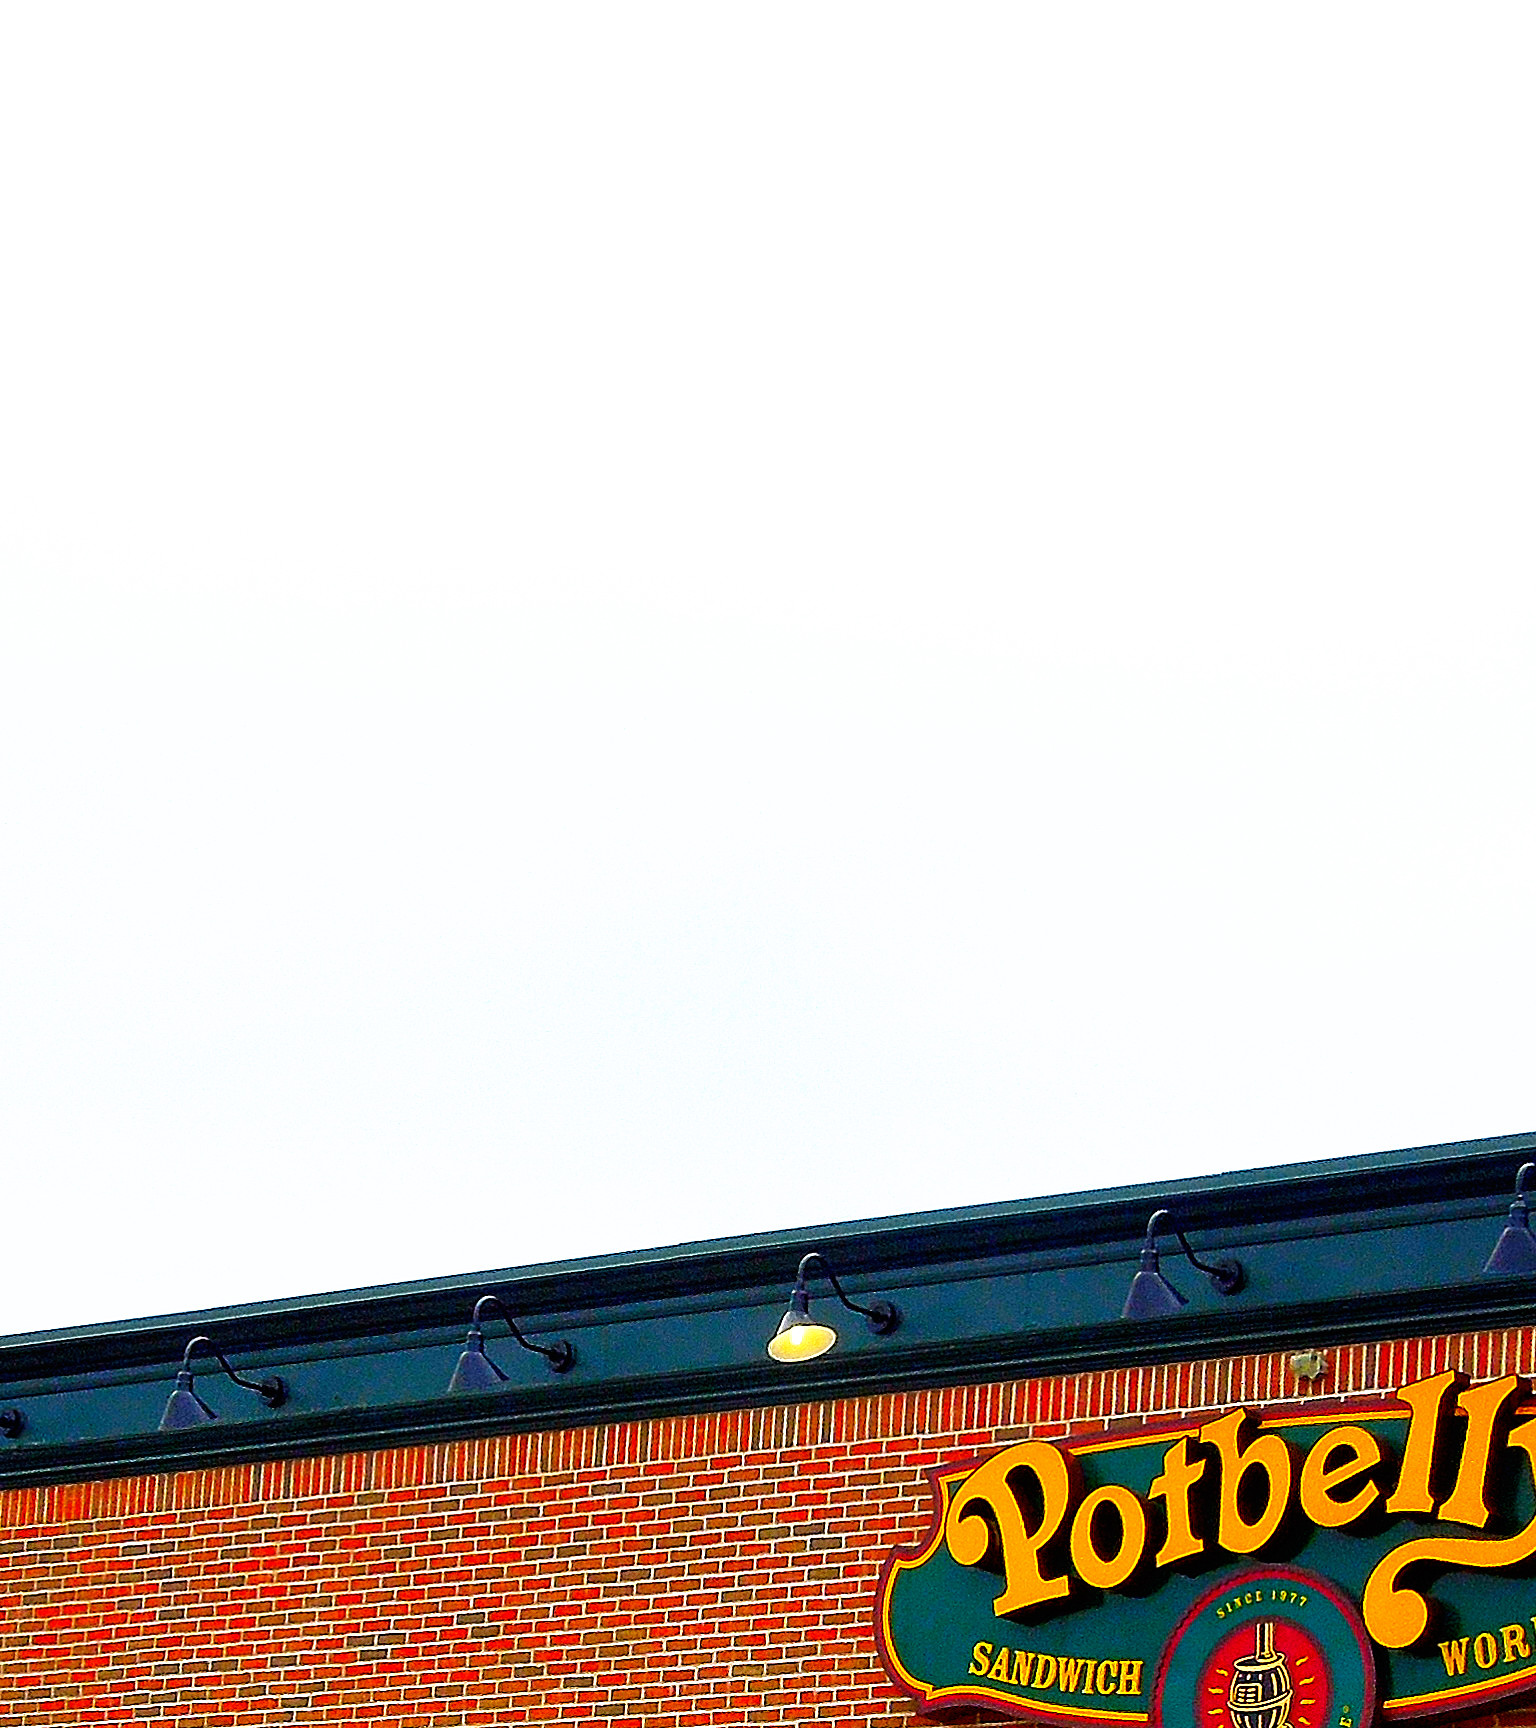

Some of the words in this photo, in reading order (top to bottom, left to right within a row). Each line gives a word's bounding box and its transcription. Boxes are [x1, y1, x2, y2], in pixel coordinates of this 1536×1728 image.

[1216, 1590, 1263, 1619] SINCE
[1271, 1589, 1309, 1607] 1977
[967, 1641, 1144, 1697] SANDWICH
